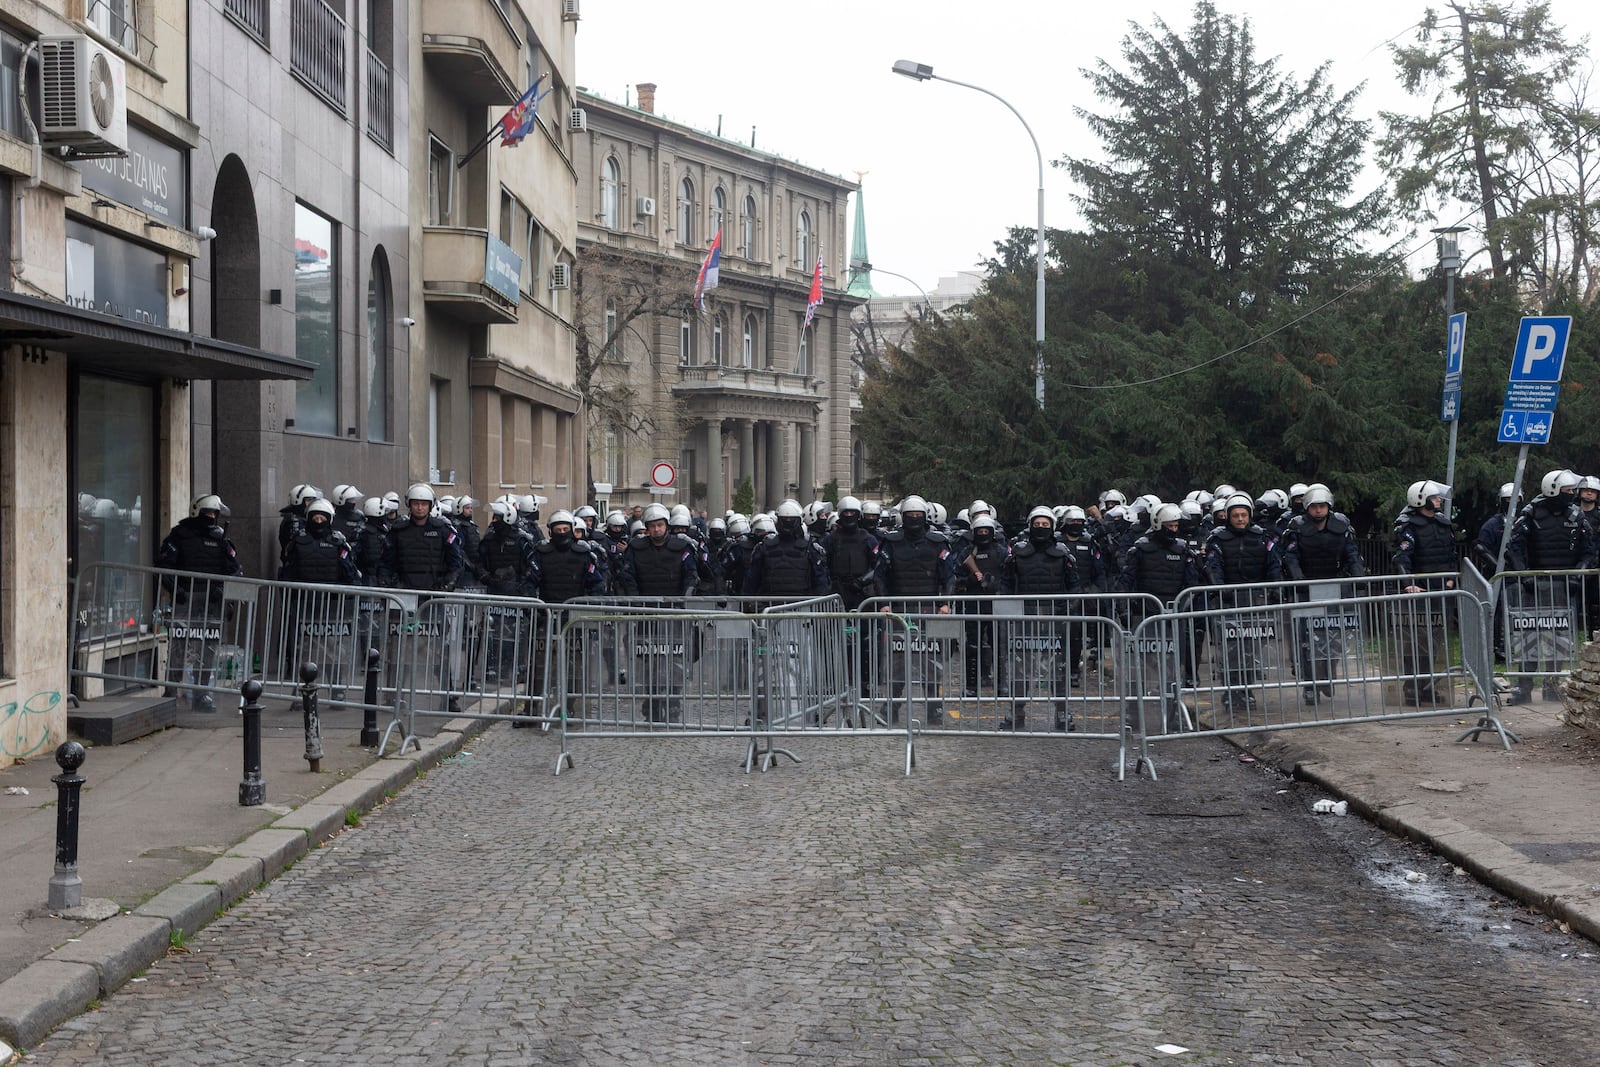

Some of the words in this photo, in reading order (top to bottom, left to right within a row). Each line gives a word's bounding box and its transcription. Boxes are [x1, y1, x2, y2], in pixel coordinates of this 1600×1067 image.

[133, 152, 149, 192] IZA
[148, 160, 168, 200] NAS
[1449, 322, 1460, 368] P
[1522, 324, 1556, 374] P
[1514, 618, 1568, 630] ПОЛИЦИЈА
